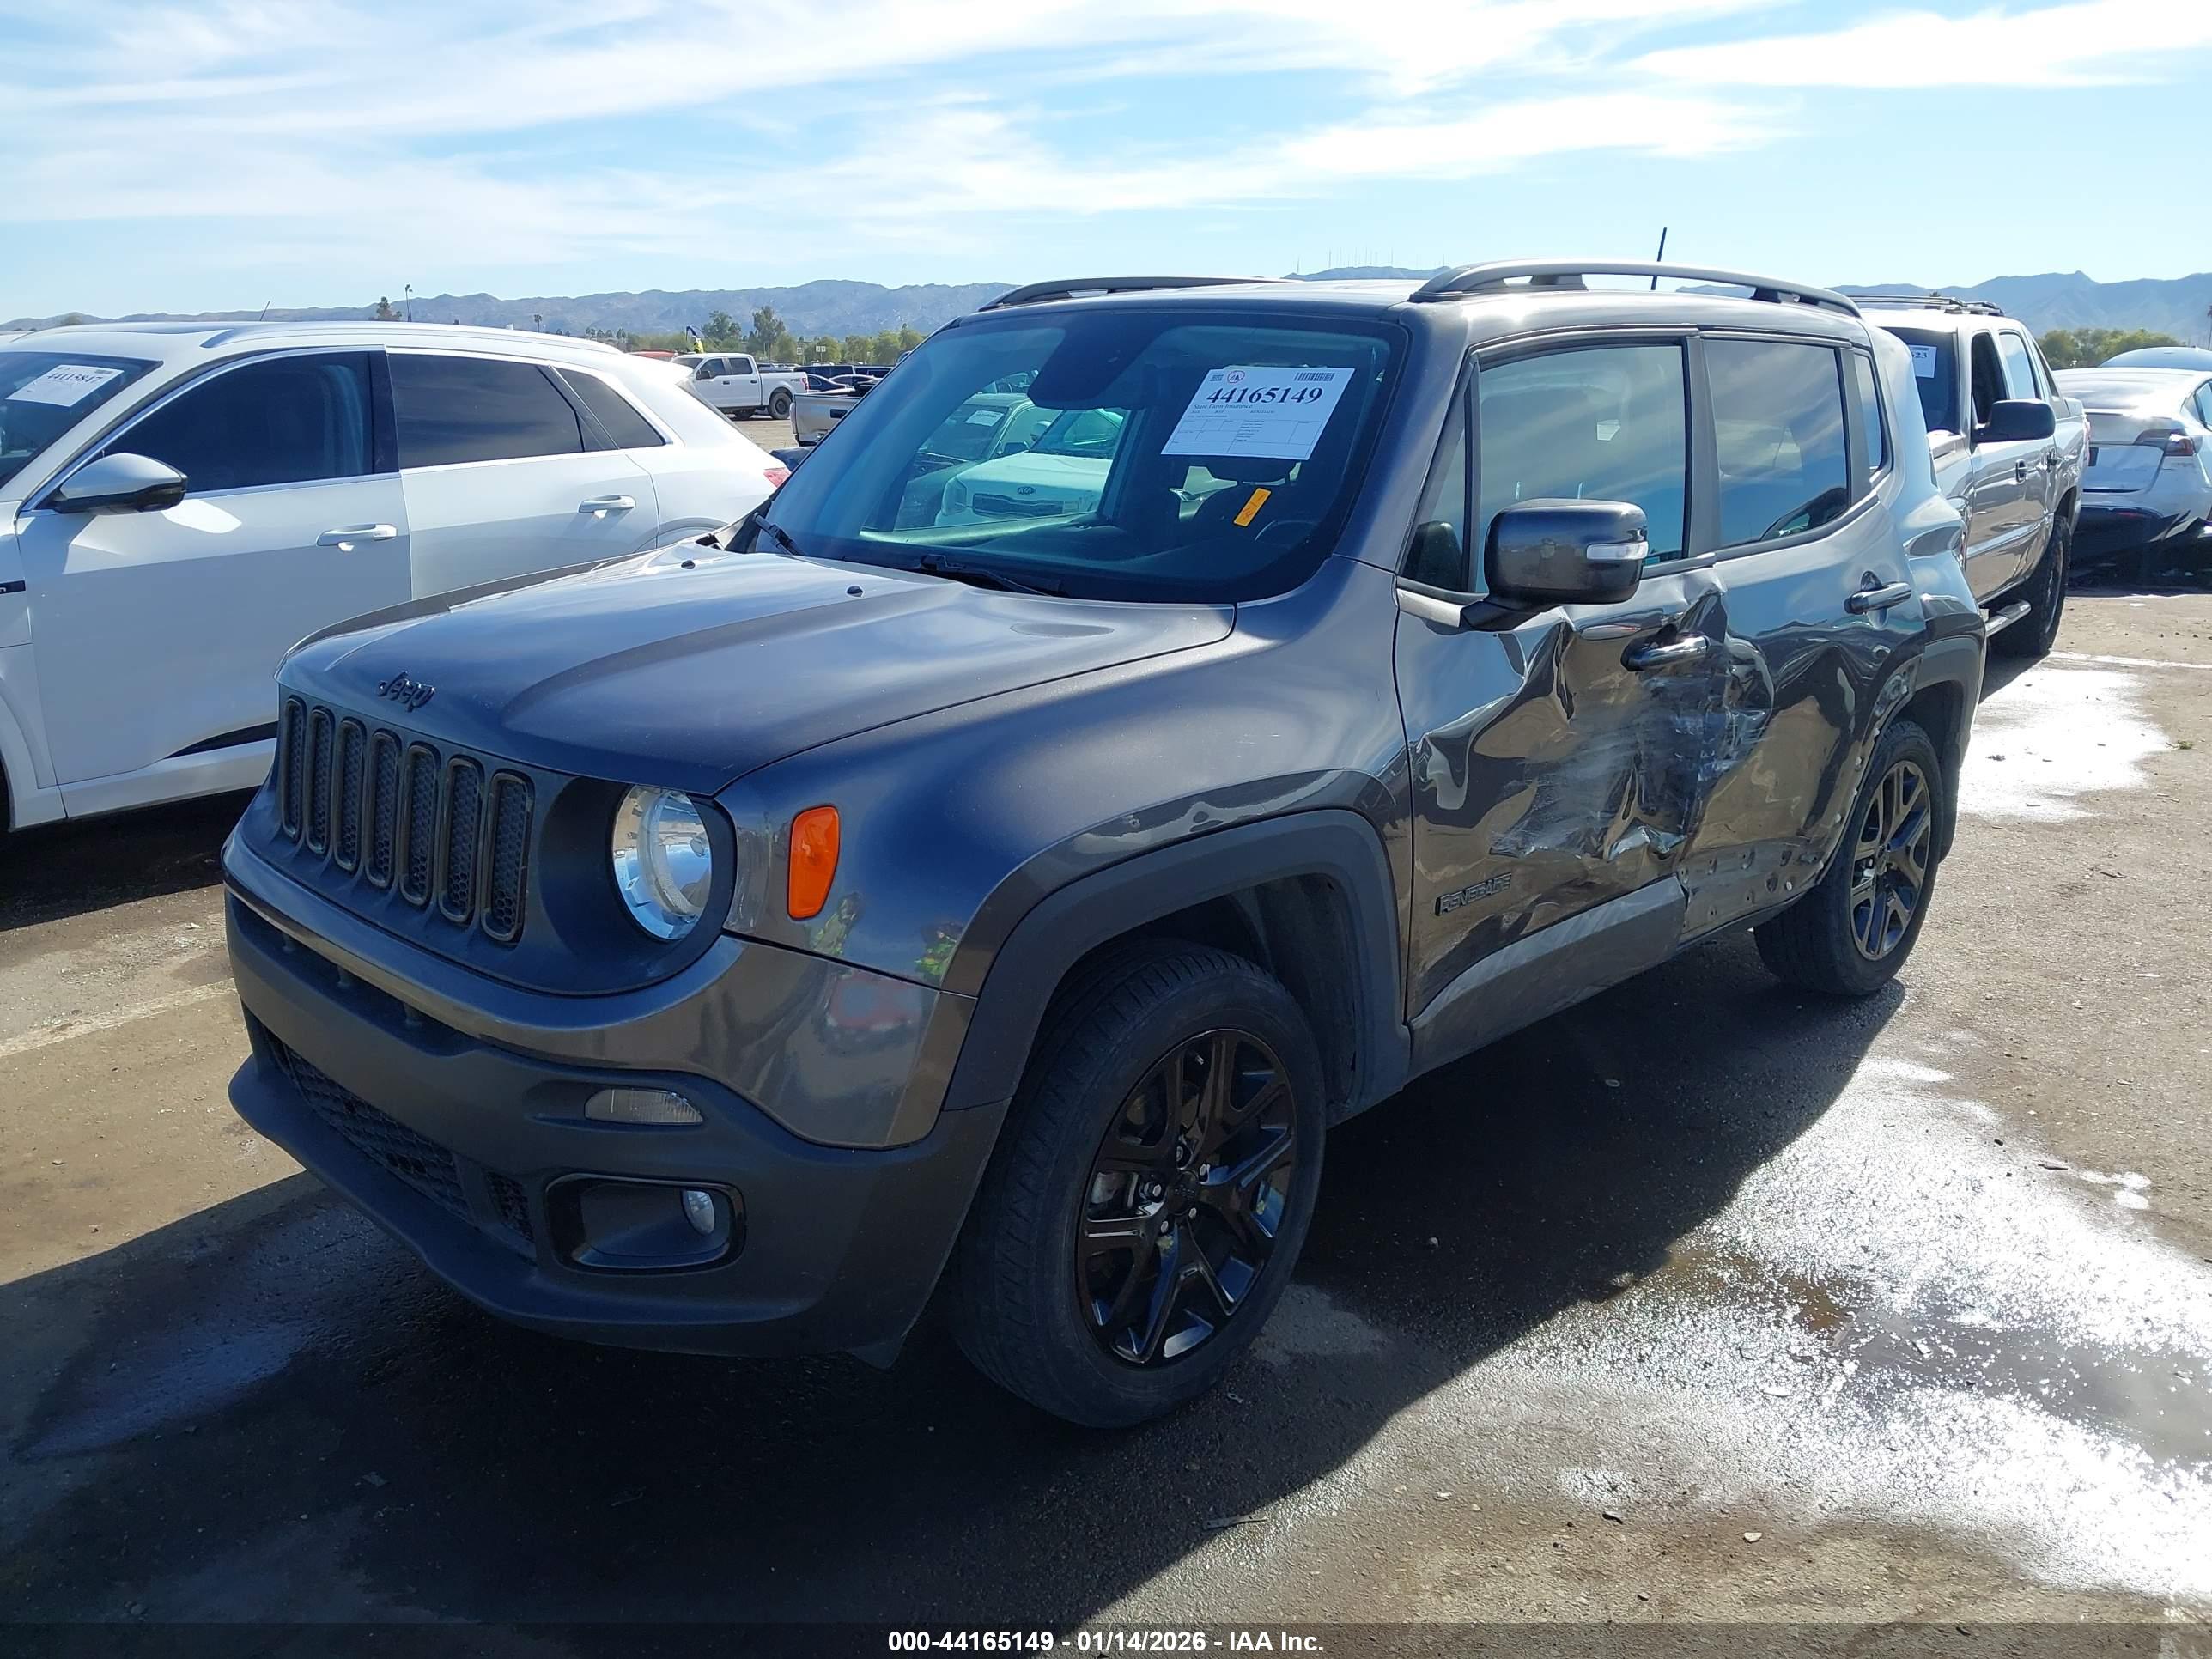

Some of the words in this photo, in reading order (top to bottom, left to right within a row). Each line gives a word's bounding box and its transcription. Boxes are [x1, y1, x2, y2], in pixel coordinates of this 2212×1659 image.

[1206, 386, 1324, 404] 44165149
[377, 670, 436, 713] Jeep
[1435, 872, 1512, 916] RENEGADE
